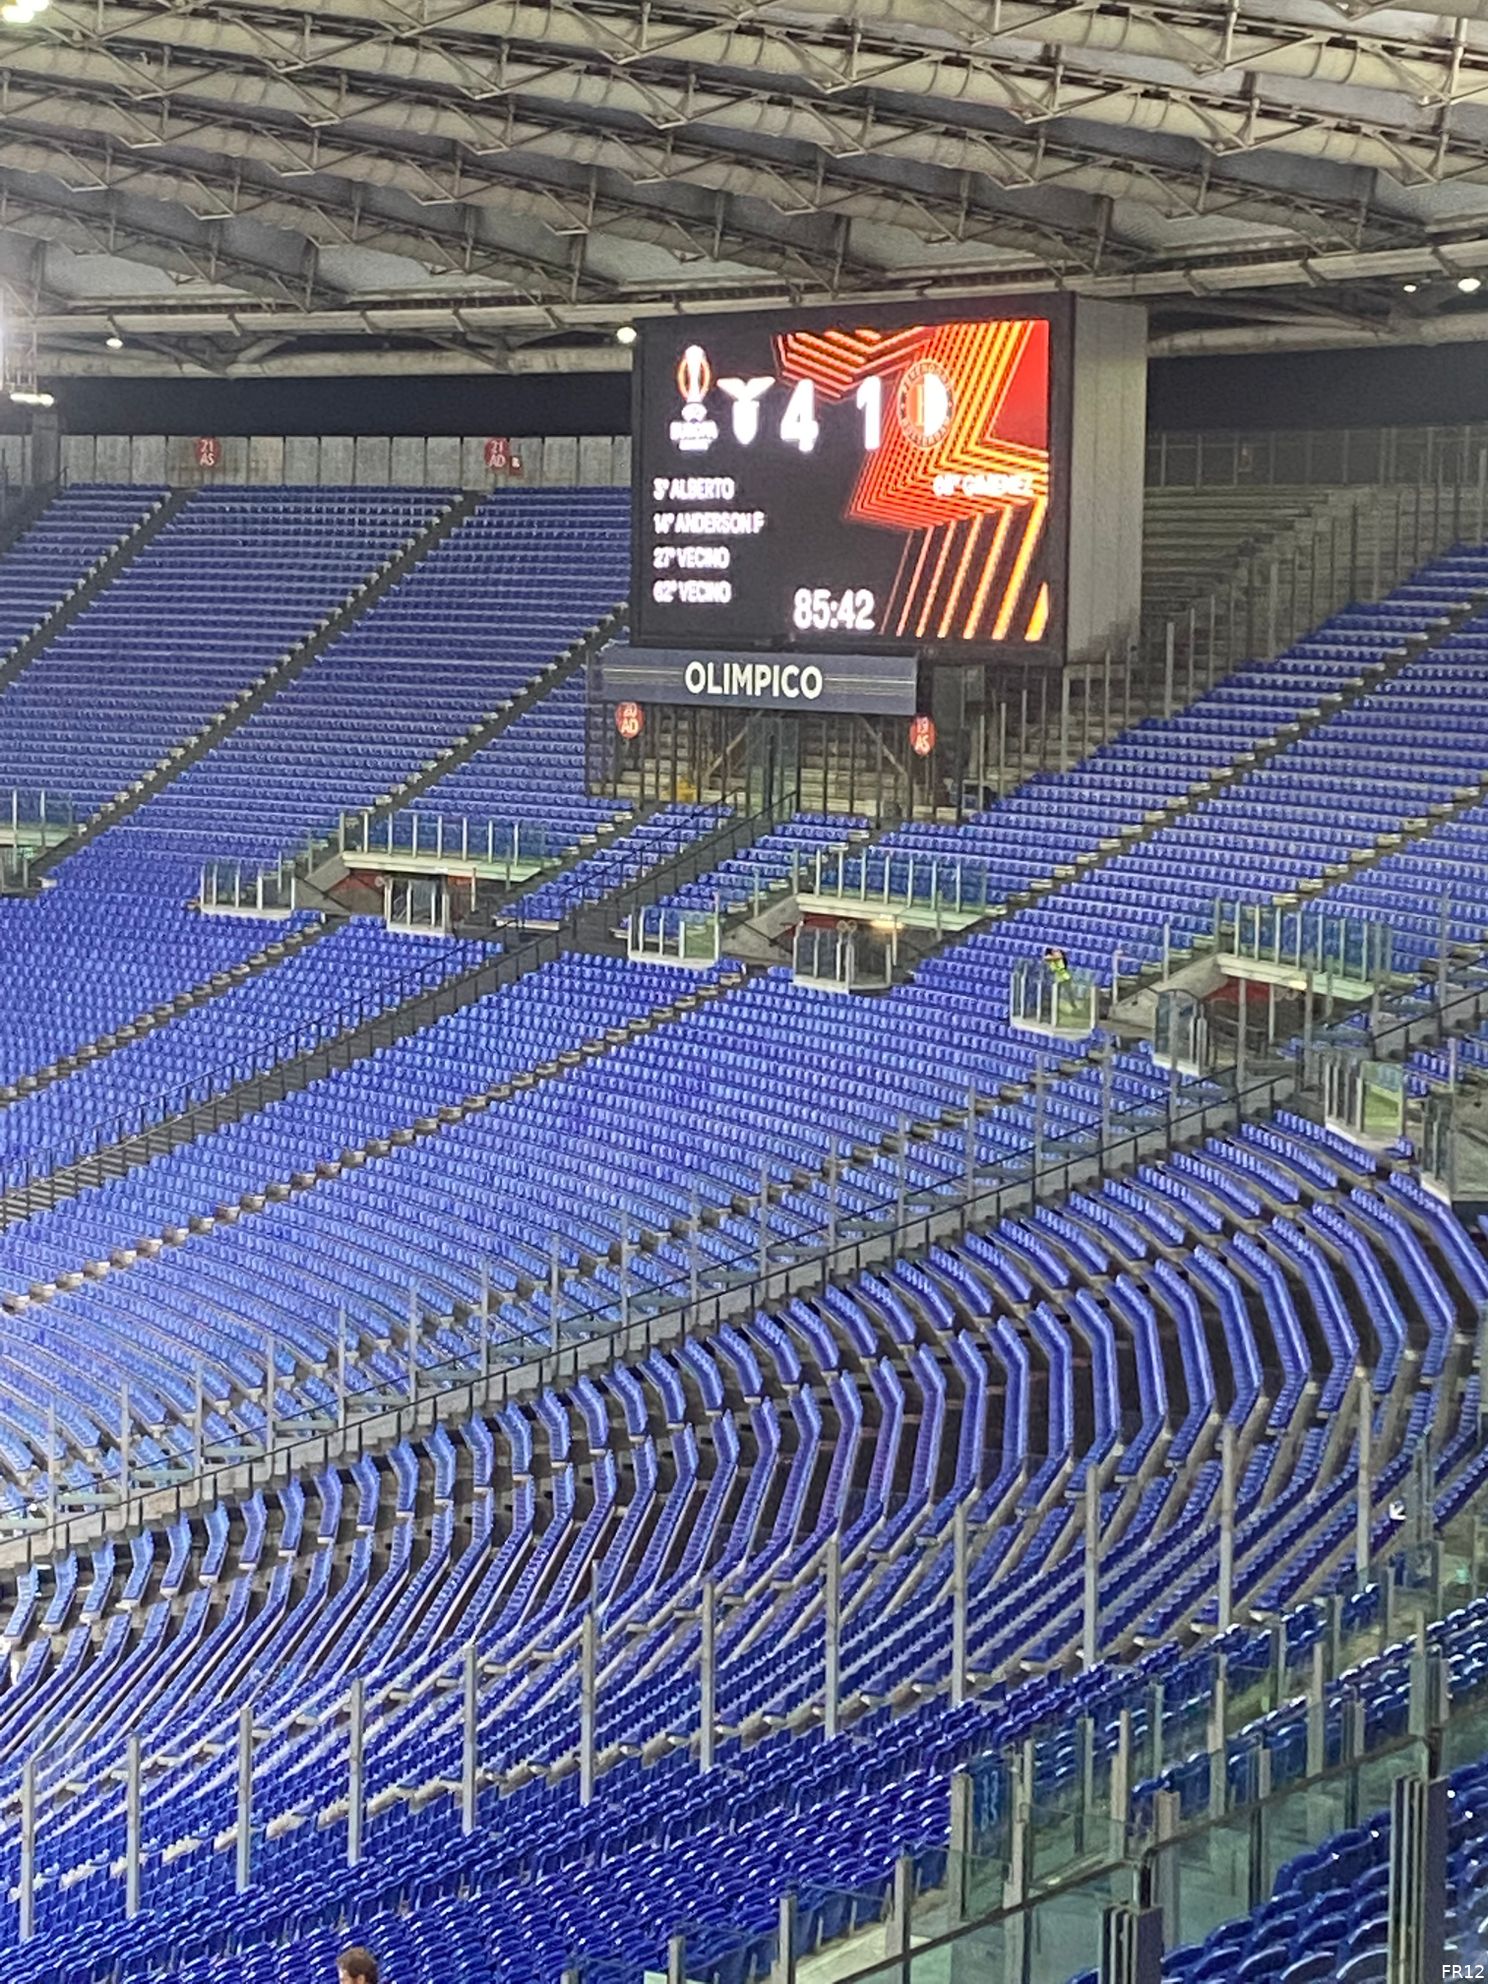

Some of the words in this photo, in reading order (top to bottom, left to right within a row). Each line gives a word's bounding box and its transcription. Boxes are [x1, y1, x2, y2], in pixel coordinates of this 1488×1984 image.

[780, 379, 819, 452] 4
[856, 375, 881, 450] 1
[200, 439, 213, 452] 21
[491, 440, 503, 453] 21
[200, 453, 215, 466] AS
[490, 454, 506, 468] AD
[669, 477, 735, 500] ALBERTO
[674, 511, 752, 534] ANDERSON
[752, 511, 765, 534] F
[676, 546, 730, 569] VECINO
[677, 580, 732, 603] VECINO
[793, 588, 876, 630] 85:42
[684, 660, 824, 700] OLIMPICO
[621, 718, 639, 734] AD
[914, 734, 930, 754] AS
